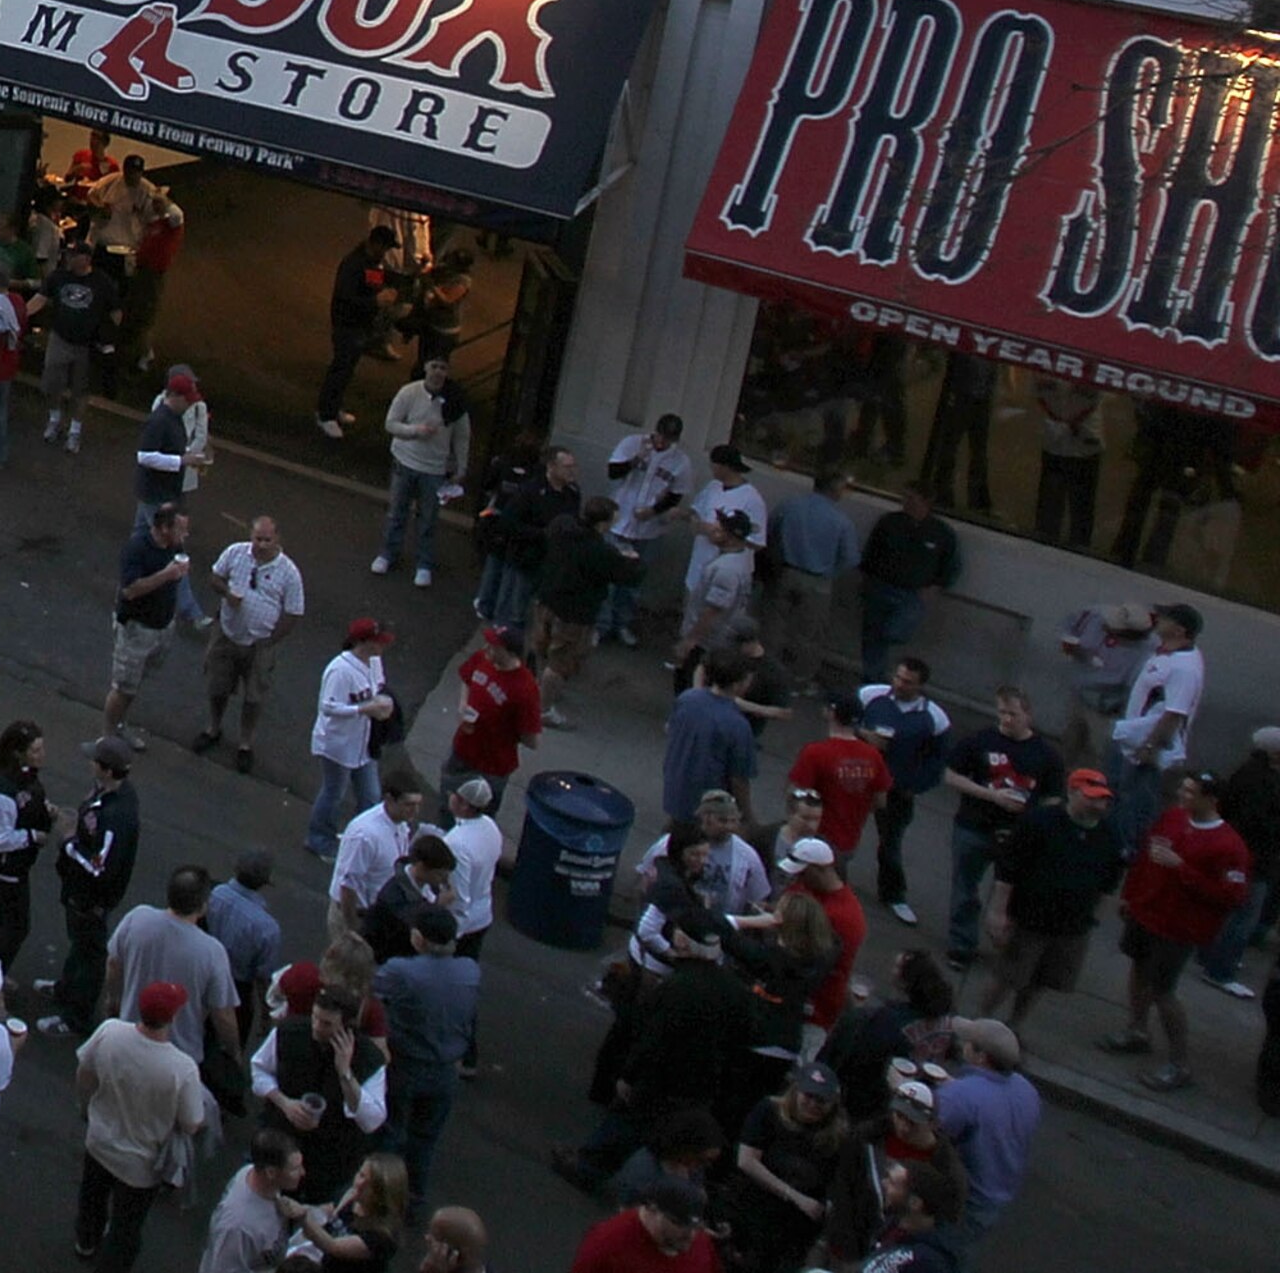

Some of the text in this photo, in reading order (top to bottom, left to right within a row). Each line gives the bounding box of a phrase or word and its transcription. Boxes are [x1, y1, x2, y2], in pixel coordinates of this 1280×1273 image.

[11, 83, 70, 113] Souvenir
[73, 98, 109, 124] Store
[109, 107, 155, 136] Across
[158, 120, 195, 147] From
[197, 130, 255, 162] Fenway
[214, 50, 513, 155] STORE
[848, 300, 1258, 421] OPEN YEAR ROUND
